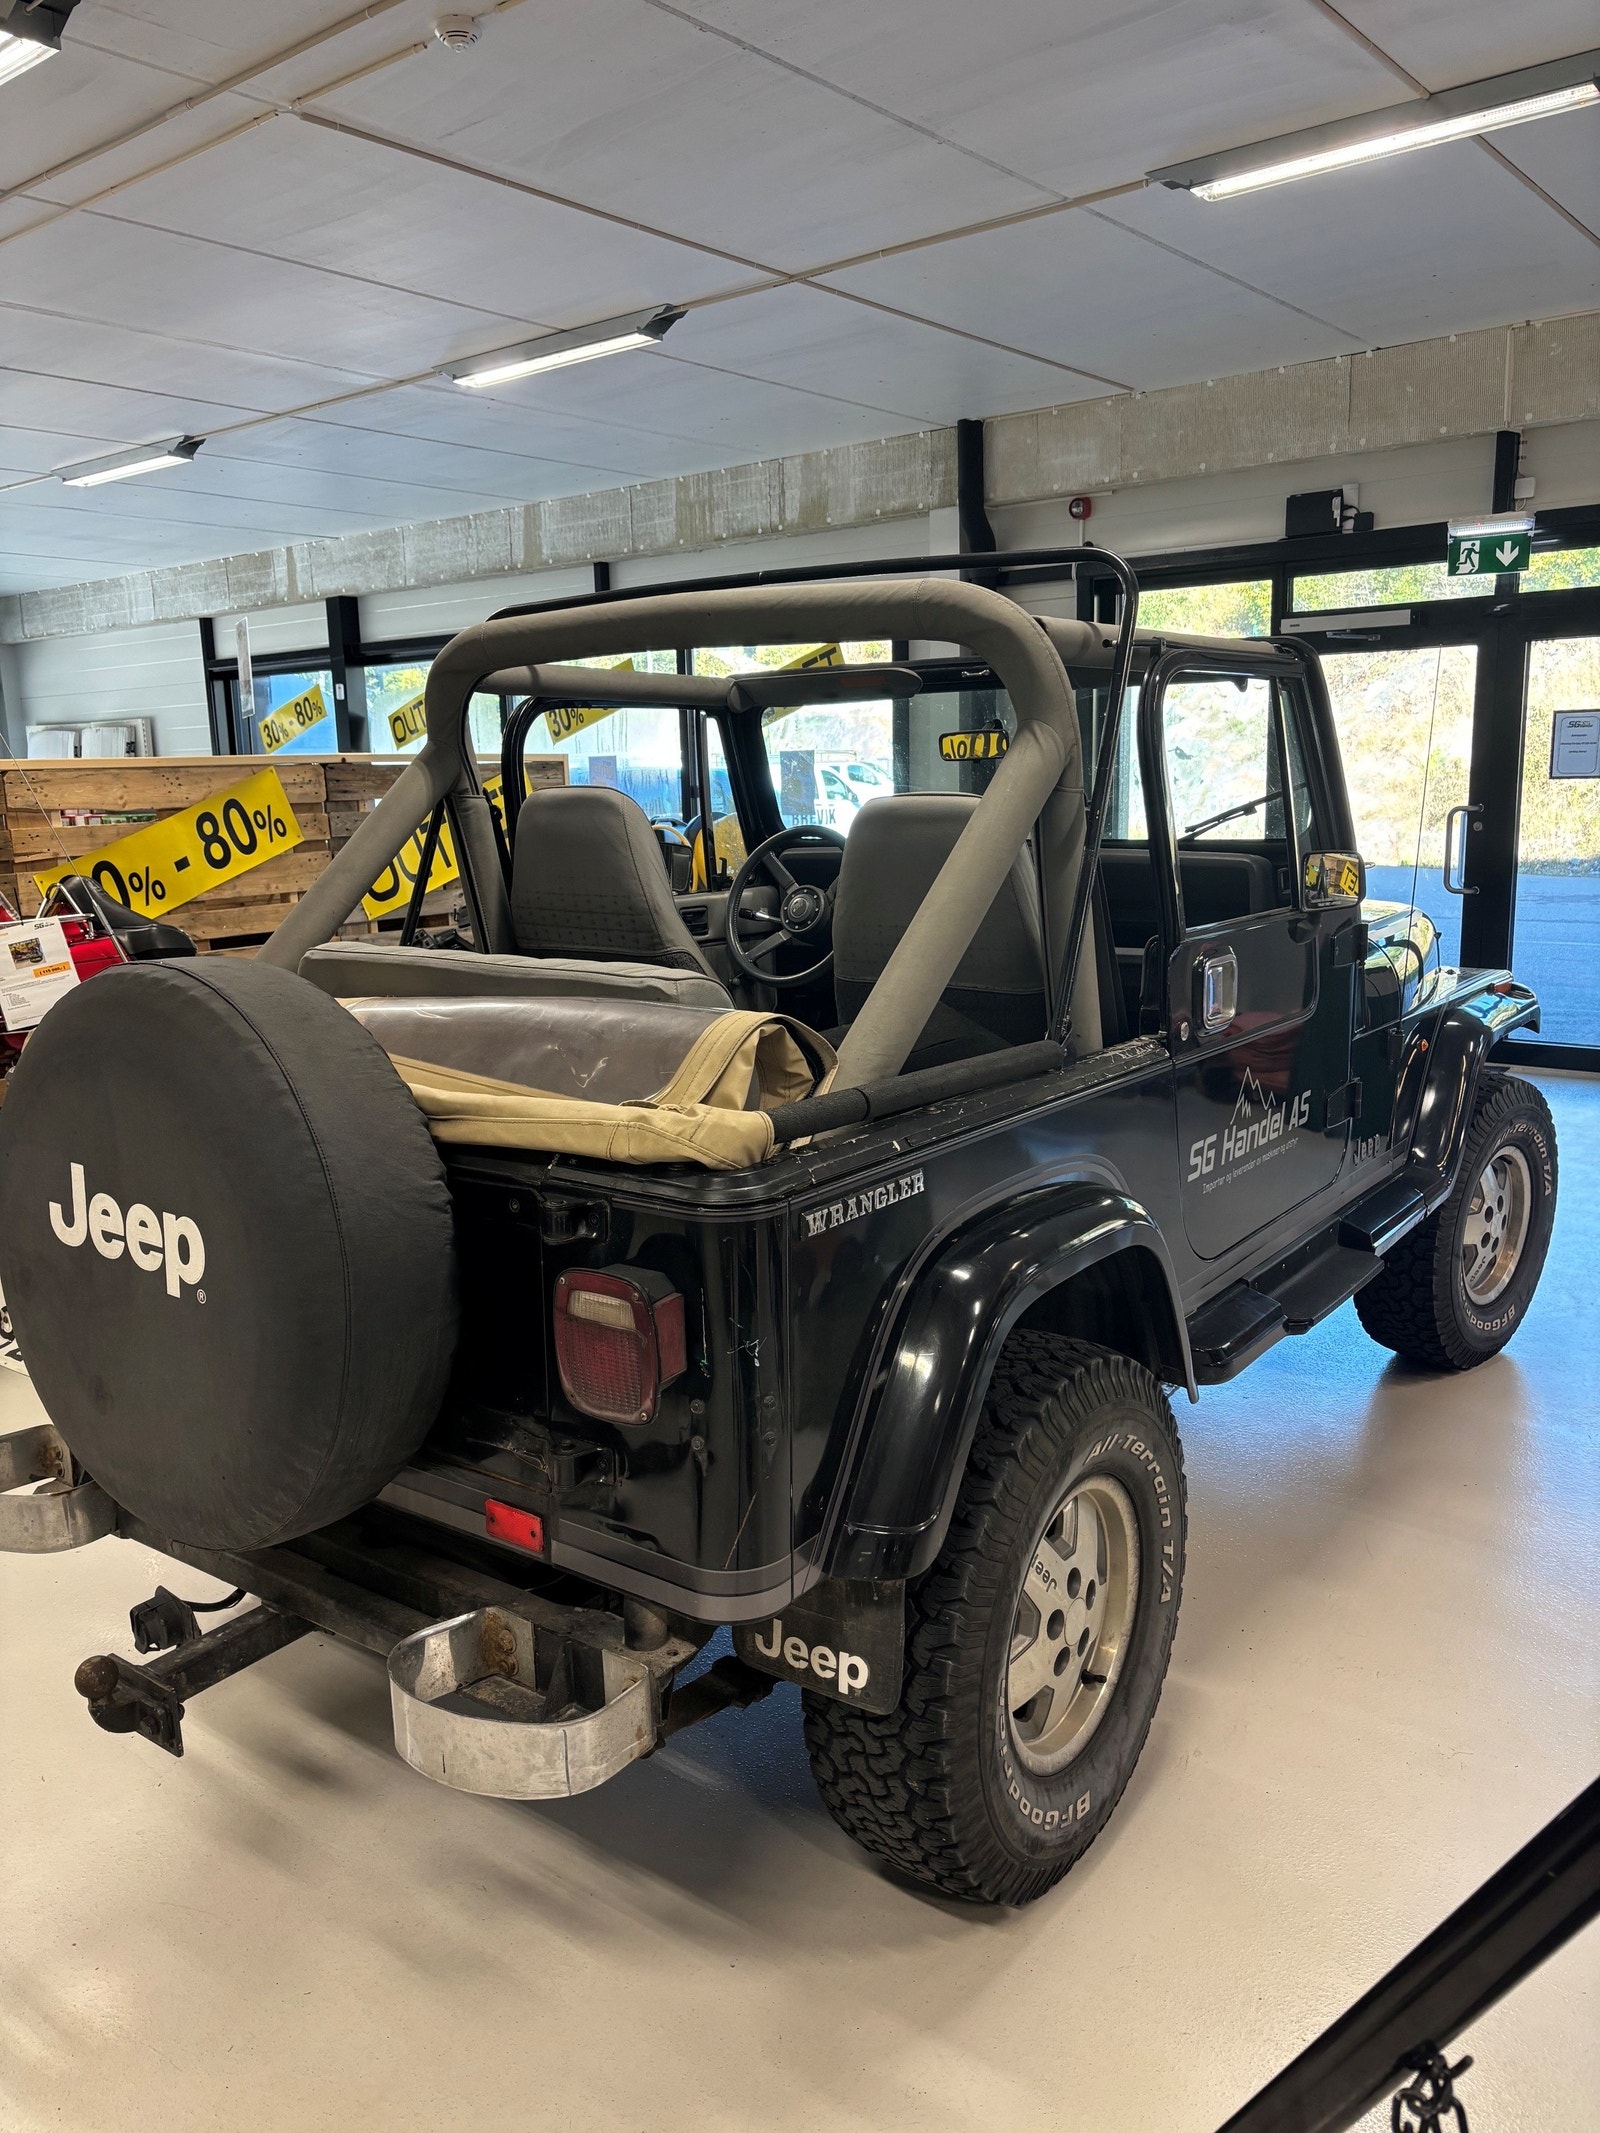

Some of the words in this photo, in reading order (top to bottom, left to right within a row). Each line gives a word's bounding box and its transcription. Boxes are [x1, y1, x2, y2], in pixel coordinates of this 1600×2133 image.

[263, 719, 289, 749] 30%
[294, 696, 323, 727] 80%
[195, 798, 287, 870] 80%
[792, 808, 837, 826] BREVIK
[1187, 1133, 1218, 1182] SG
[1221, 1101, 1286, 1166] Handel
[1288, 1089, 1312, 1132] AS
[1353, 1133, 1381, 1166] Jeep
[805, 1170, 925, 1237] WRANGLER
[1543, 1161, 1553, 1196] T/A
[49, 1162, 206, 1299] Jeep
[1160, 1540, 1174, 1603] T/A
[755, 1618, 869, 1695] Jeep
